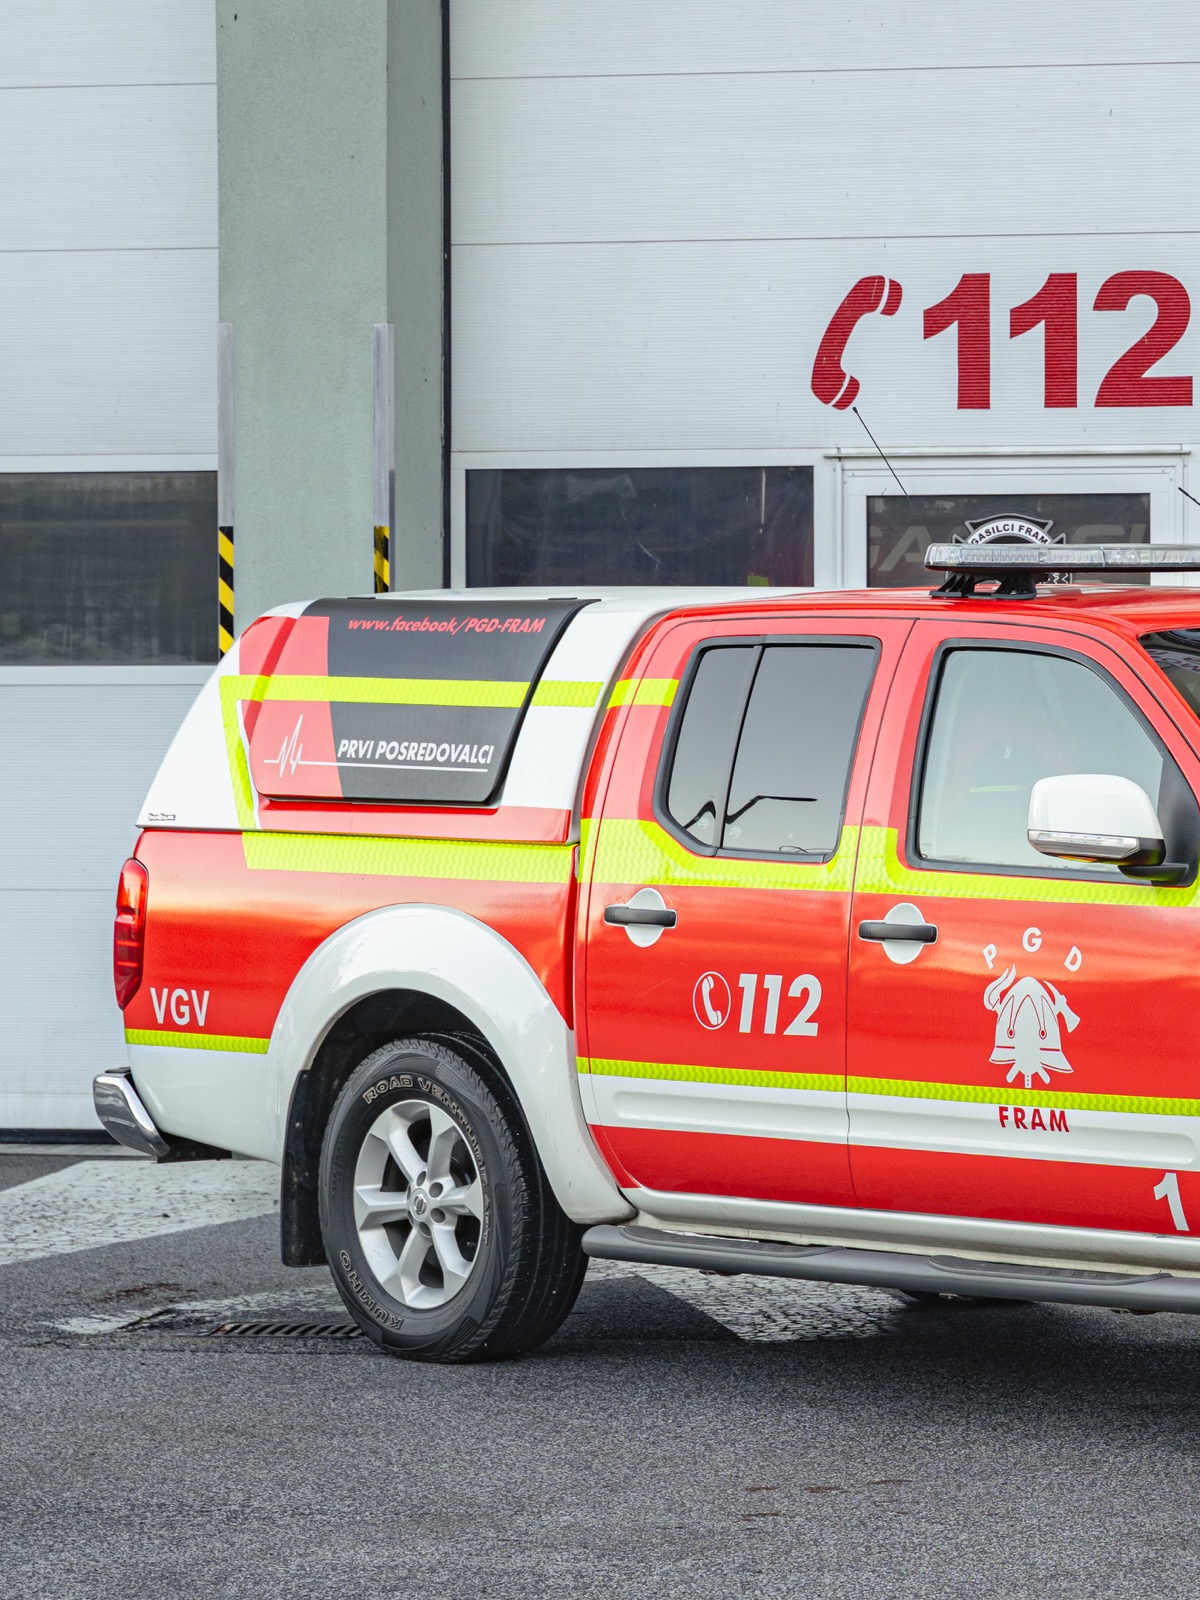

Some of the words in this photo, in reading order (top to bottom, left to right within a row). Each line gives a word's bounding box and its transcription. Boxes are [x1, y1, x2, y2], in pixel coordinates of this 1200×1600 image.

[923, 270, 1193, 410] 112
[971, 524, 1014, 544] GASILCI
[1018, 525, 1049, 544] FRAM
[348, 616, 546, 636] www.facebook/PGD-FRAM
[337, 739, 375, 760] PRVI
[375, 740, 494, 765] POSREDOVALCI
[150, 987, 210, 1026] VGV
[738, 973, 822, 1037] 112
[362, 1075, 413, 1105] ROAD
[998, 1105, 1070, 1133] FRAM
[1153, 1172, 1190, 1232] 1
[339, 1249, 403, 1331] KUMHO
